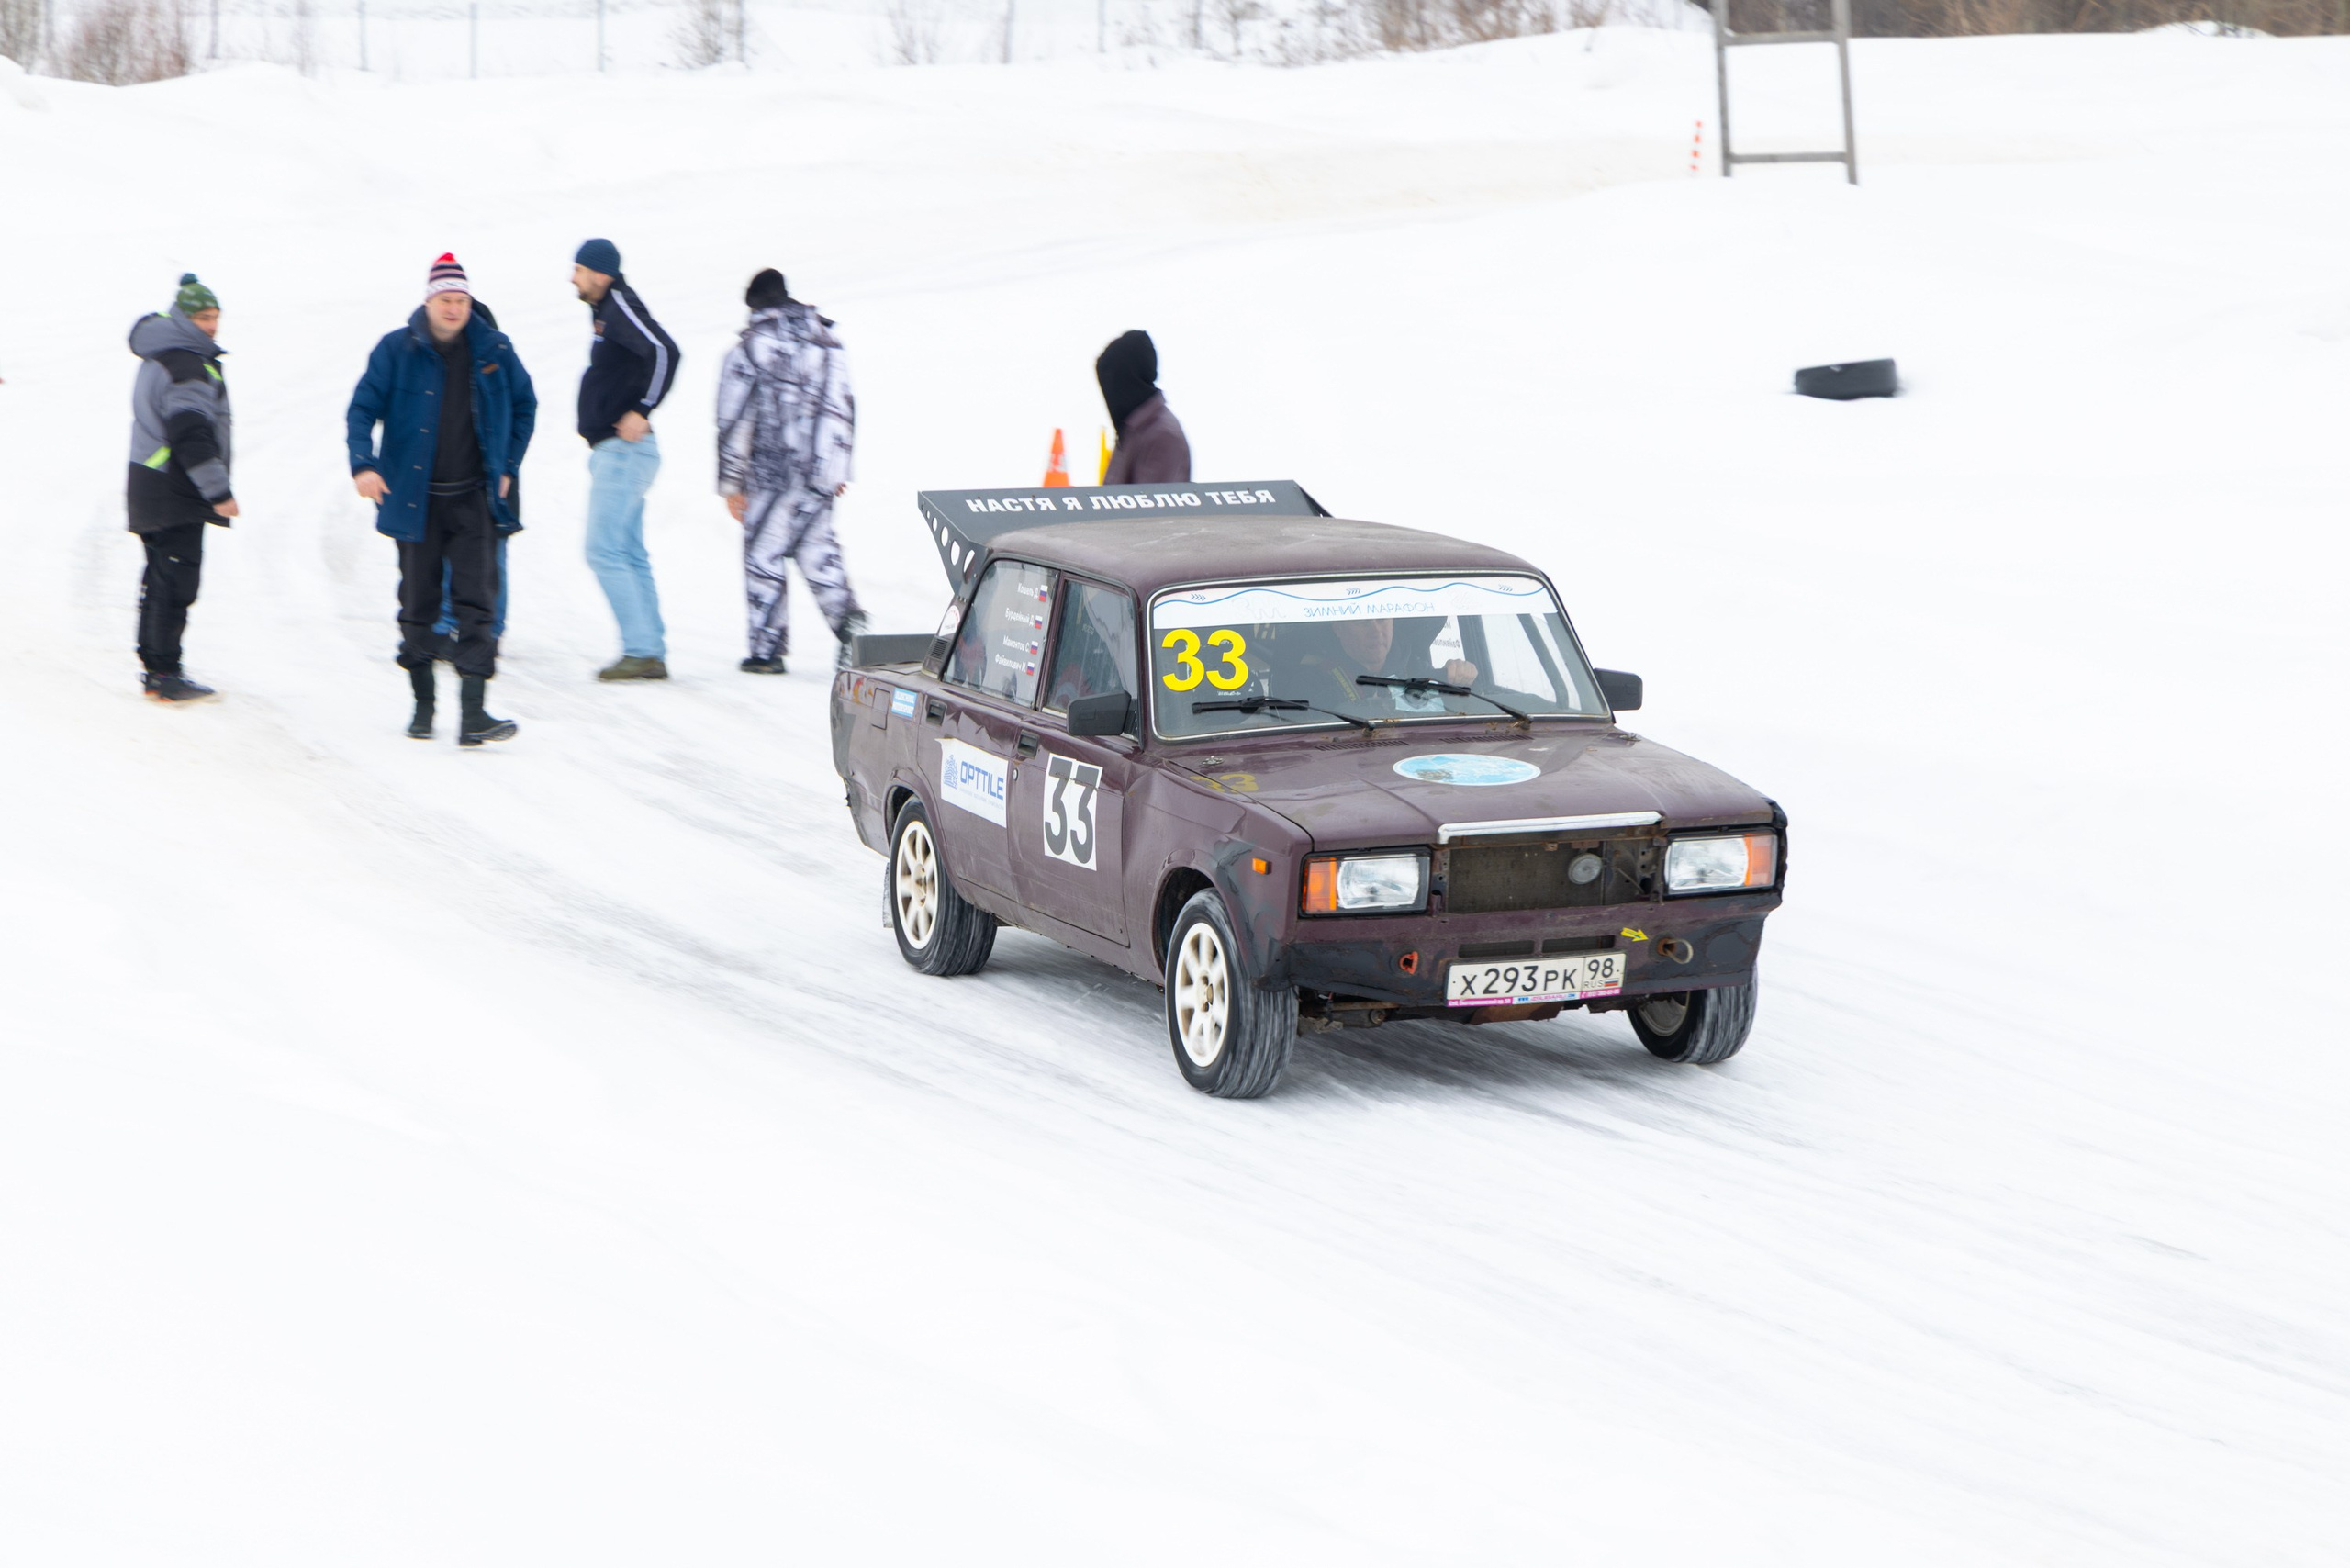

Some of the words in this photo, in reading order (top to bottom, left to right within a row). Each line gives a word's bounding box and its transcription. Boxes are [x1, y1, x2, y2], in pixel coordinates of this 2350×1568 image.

[966, 497, 1057, 512] НАСТЯ
[1062, 497, 1083, 510] Я
[1089, 492, 1202, 510] ЛЮБЛЮ
[1205, 489, 1276, 505] ТЕБЯ
[1304, 602, 1361, 618] ЗИМНИЙ
[1367, 602, 1436, 614] МАРАФОН
[1161, 628, 1248, 693] 33
[960, 760, 1004, 801] OPTTILE
[1044, 756, 1100, 865] 33
[1588, 958, 1615, 980] 98
[1584, 980, 1604, 989] RUS
